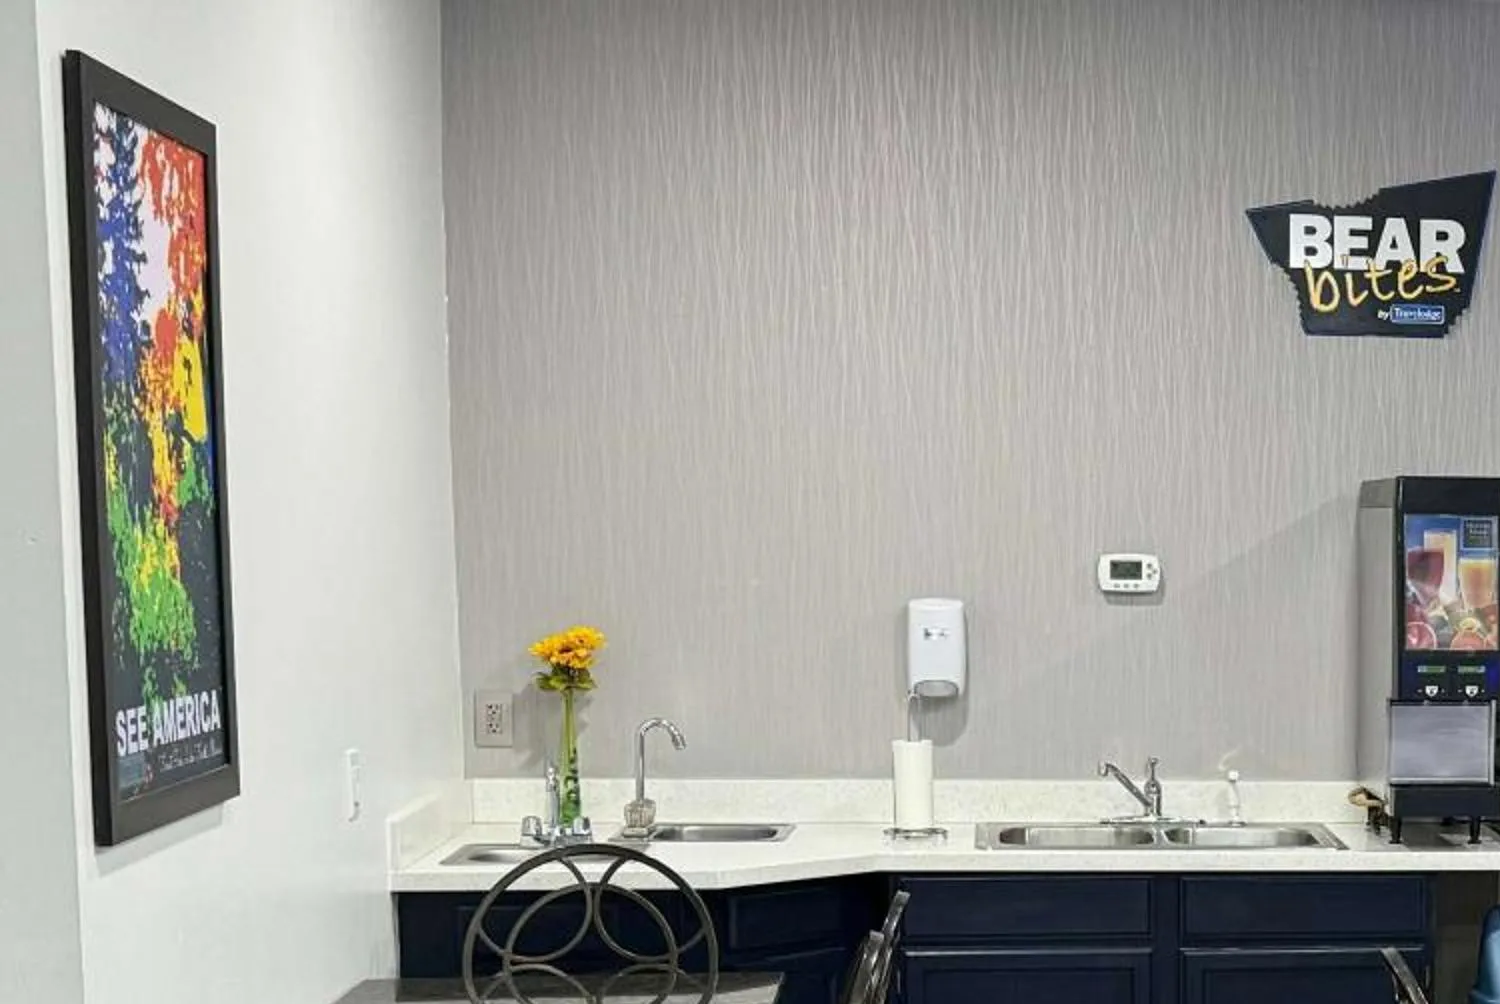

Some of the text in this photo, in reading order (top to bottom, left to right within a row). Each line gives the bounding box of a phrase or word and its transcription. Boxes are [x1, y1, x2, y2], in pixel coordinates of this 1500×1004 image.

[1289, 213, 1466, 274] BEAR
[1304, 254, 1455, 313] bites
[1377, 309, 1389, 321] by
[116, 705, 149, 758] SEE
[151, 689, 221, 748] AMERICA
